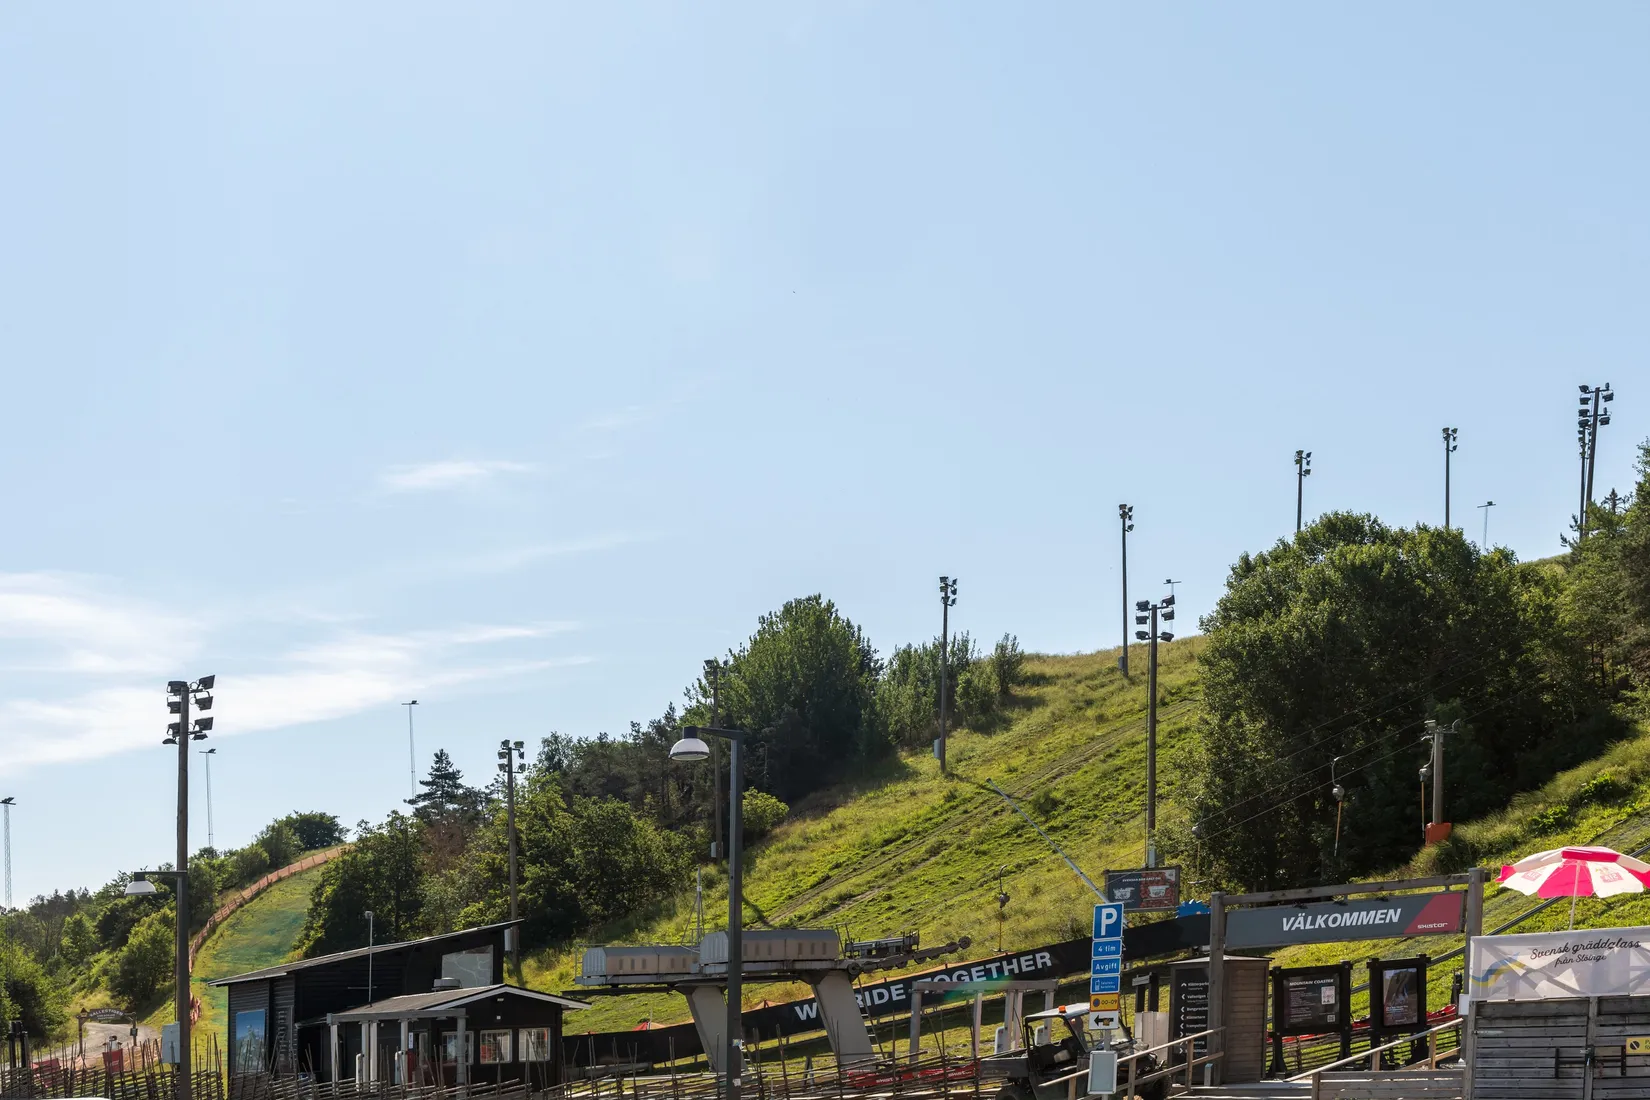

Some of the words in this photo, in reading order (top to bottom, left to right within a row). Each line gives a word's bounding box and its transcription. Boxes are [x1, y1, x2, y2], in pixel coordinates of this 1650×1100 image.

[1101, 907, 1118, 936] P
[1282, 908, 1401, 931] VÄLKOMMEN
[1530, 942, 1570, 960] Svensk
[1571, 938, 1641, 954] gräddglass
[918, 951, 1052, 982] GETHER
[1095, 963, 1117, 971] Avgift
[1554, 957, 1574, 967] från
